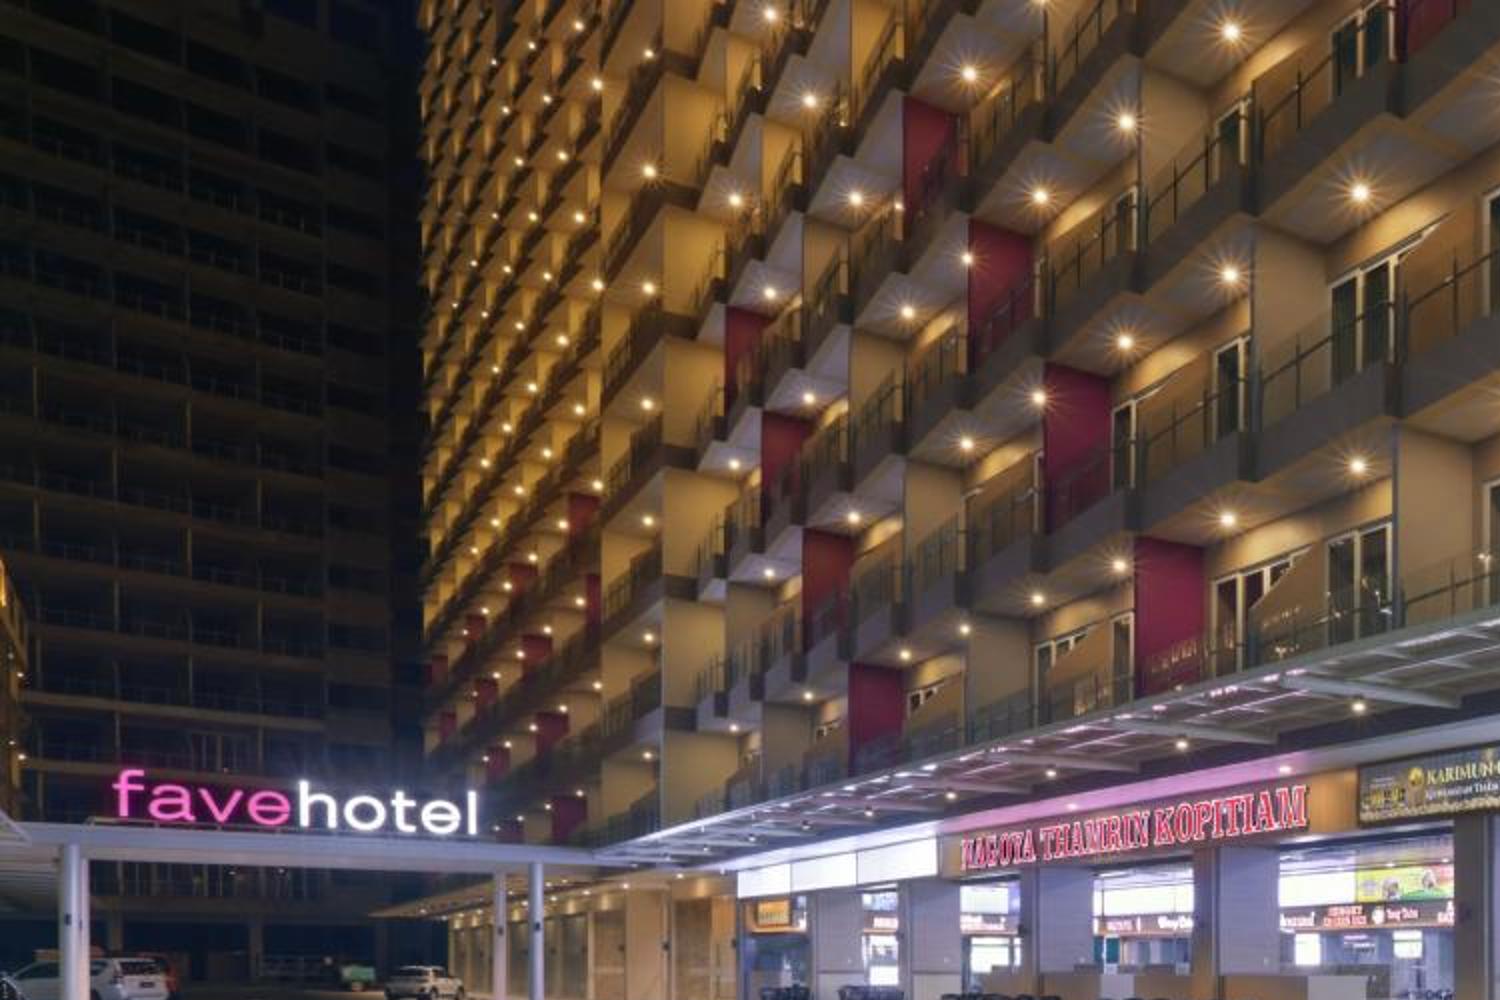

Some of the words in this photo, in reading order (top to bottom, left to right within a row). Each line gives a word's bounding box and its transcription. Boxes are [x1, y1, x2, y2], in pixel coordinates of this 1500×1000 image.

[112, 769, 478, 835] favehotel
[1427, 761, 1493, 785] KARIMUN
[1154, 785, 1308, 845] KOPITIAM
